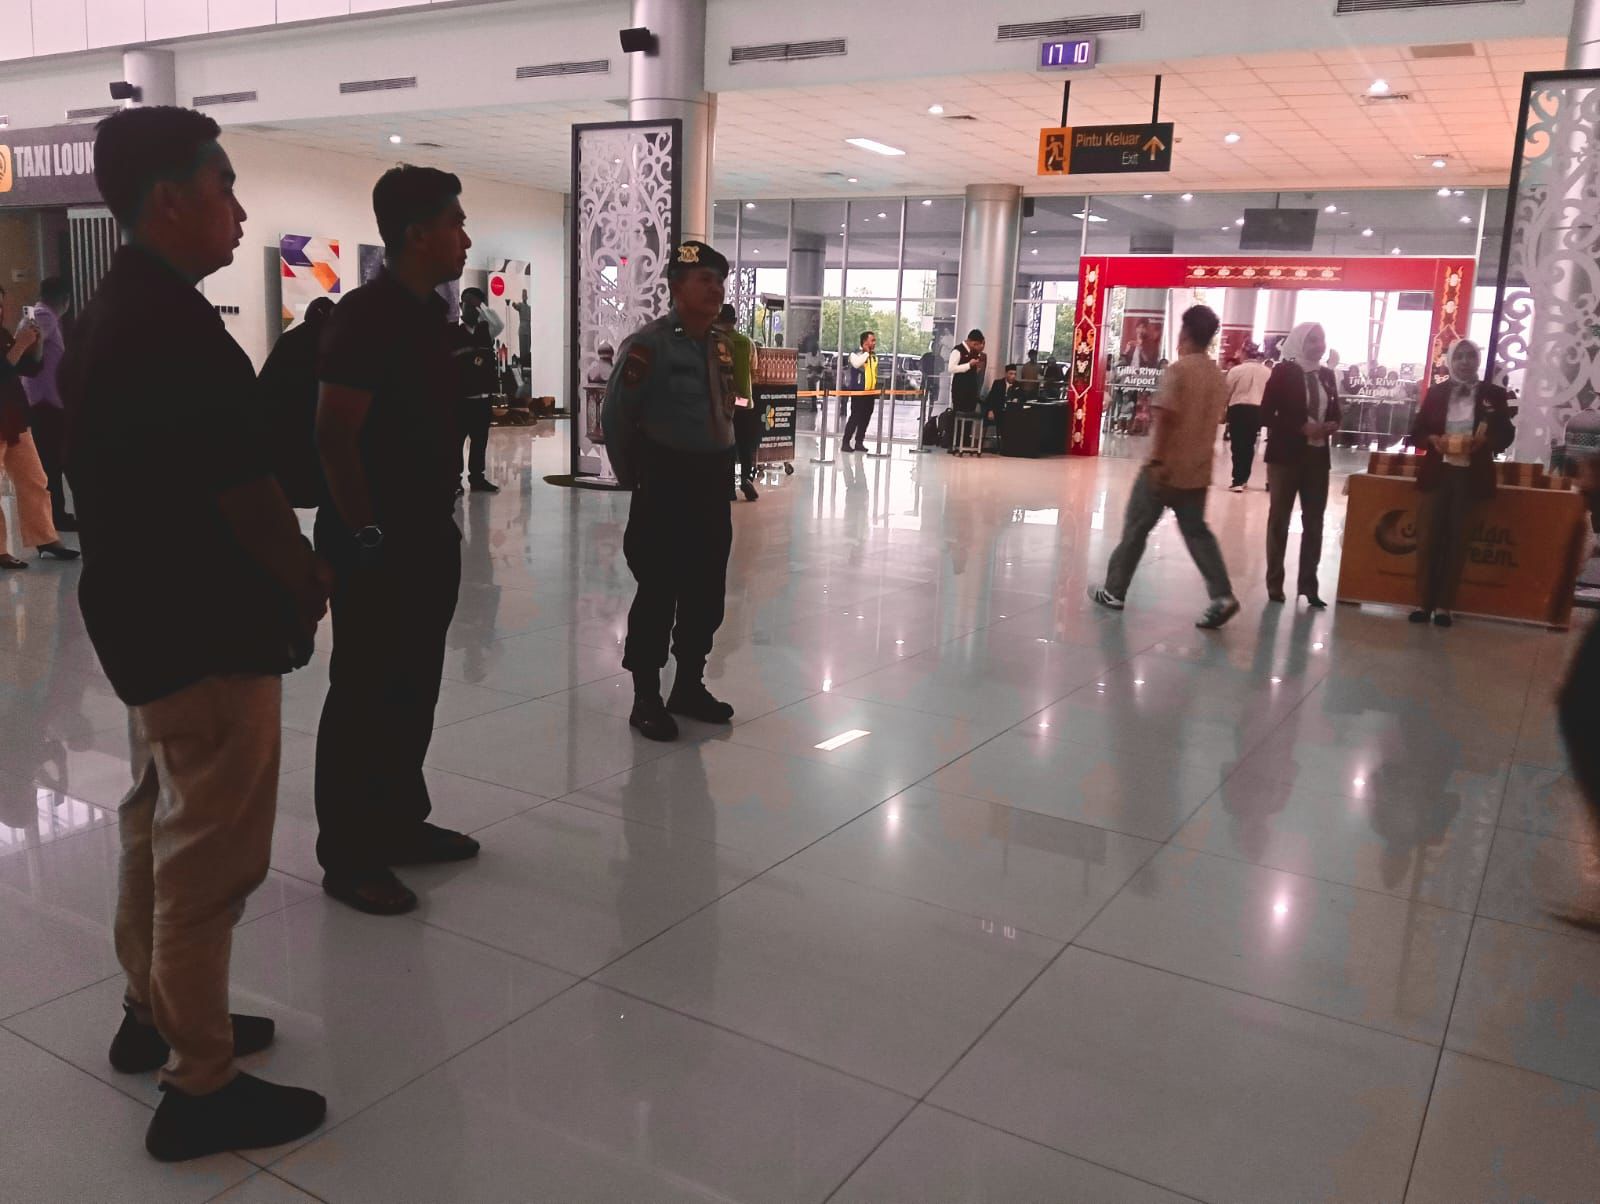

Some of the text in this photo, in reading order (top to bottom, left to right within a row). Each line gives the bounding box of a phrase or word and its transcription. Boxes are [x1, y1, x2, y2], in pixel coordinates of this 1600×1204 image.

[1048, 42, 1089, 64] 17 10
[1076, 132, 1140, 147] Pintu Keluar
[14, 145, 51, 178] TAXI
[1122, 151, 1138, 165] Exit
[1124, 375, 1156, 386] Airport
[1358, 386, 1394, 398] Airport
